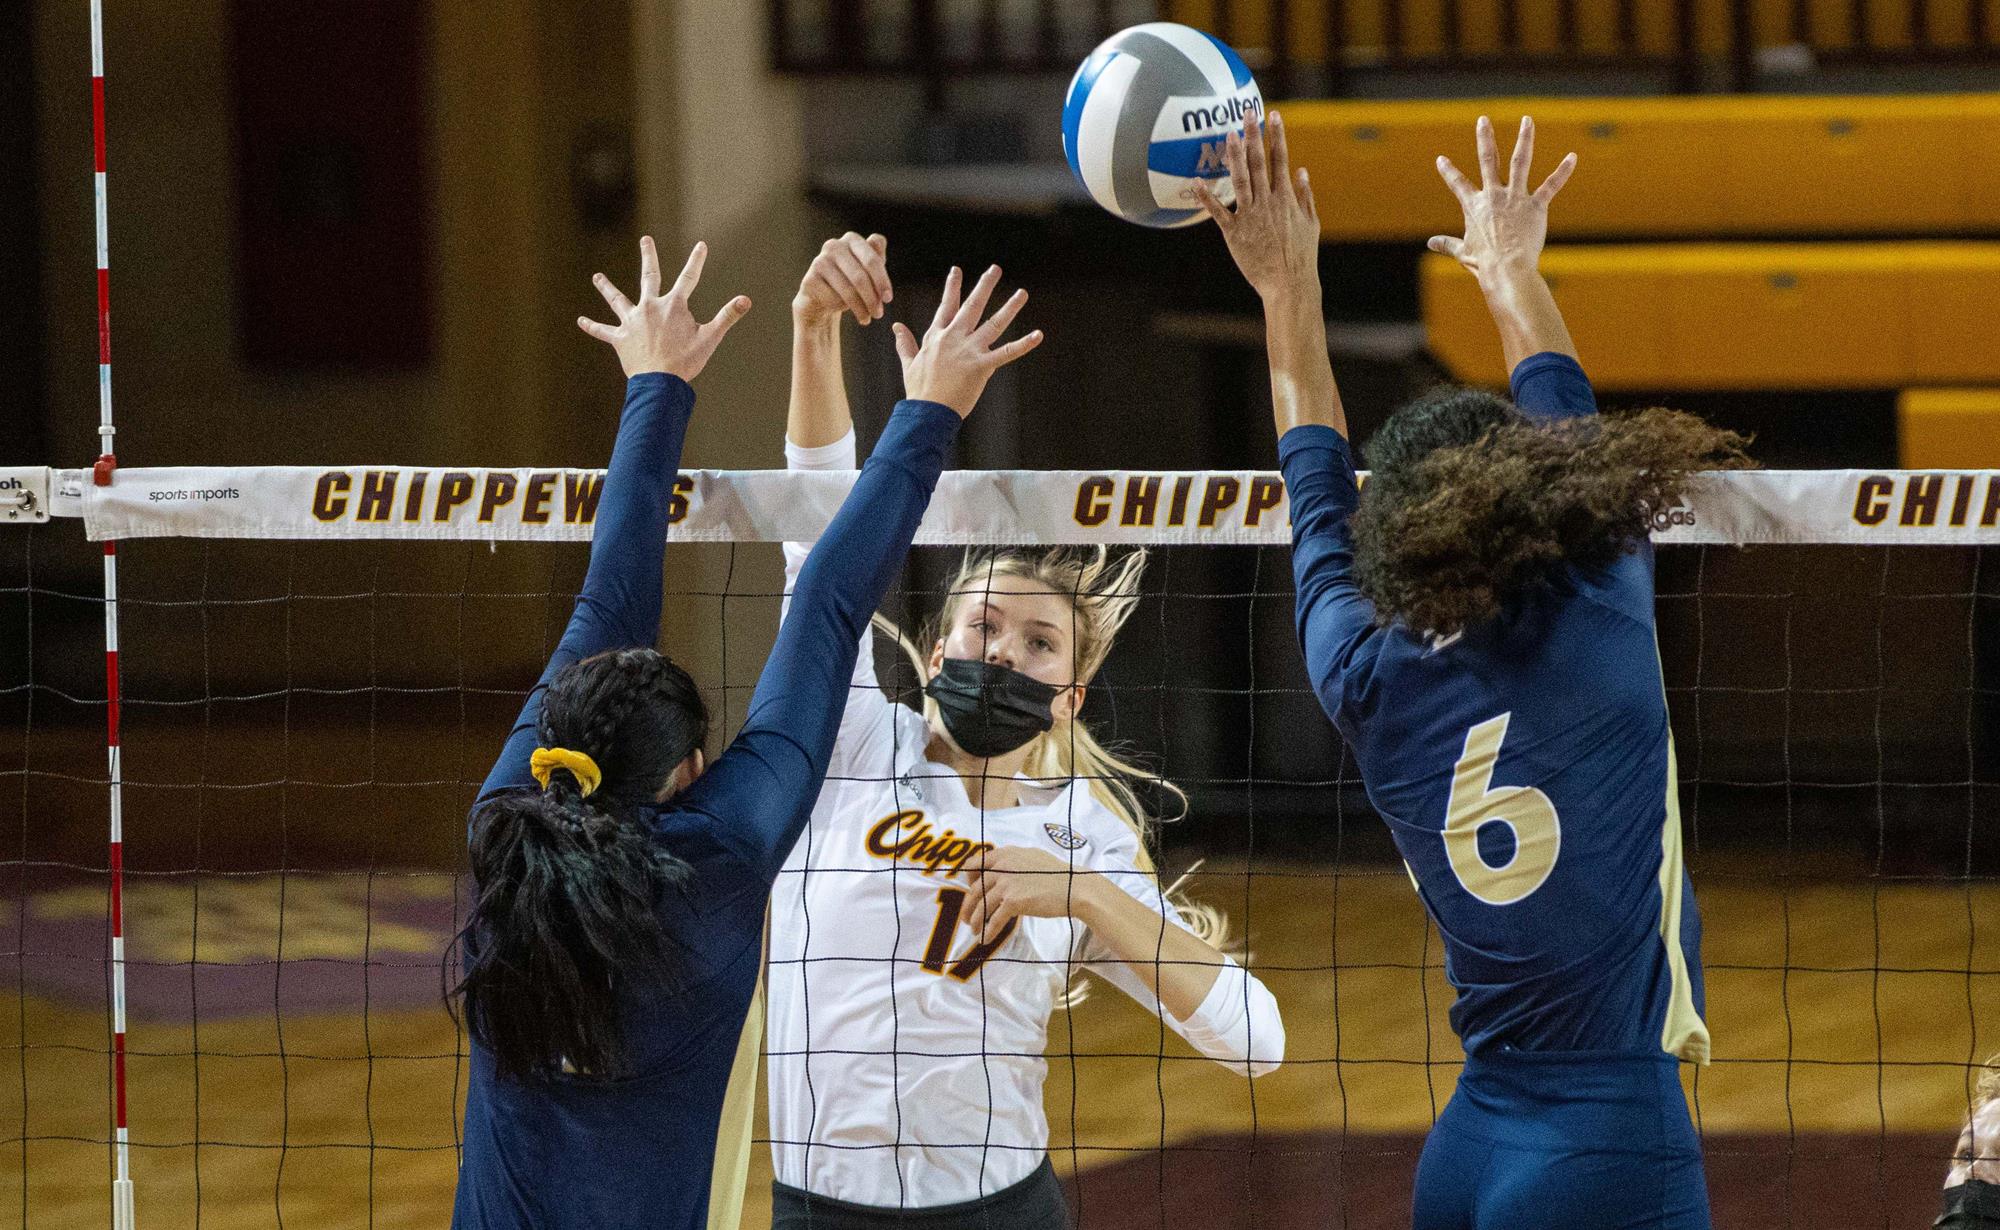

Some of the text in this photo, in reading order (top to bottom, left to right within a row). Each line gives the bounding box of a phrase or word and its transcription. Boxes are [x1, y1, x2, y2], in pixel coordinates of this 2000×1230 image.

[1182, 95, 1262, 133] molten
[149, 487, 240, 502] sports imports
[312, 471, 694, 524] CHIPPEWS
[1073, 475, 1293, 528] CHIPP
[1441, 711, 1561, 905] 6
